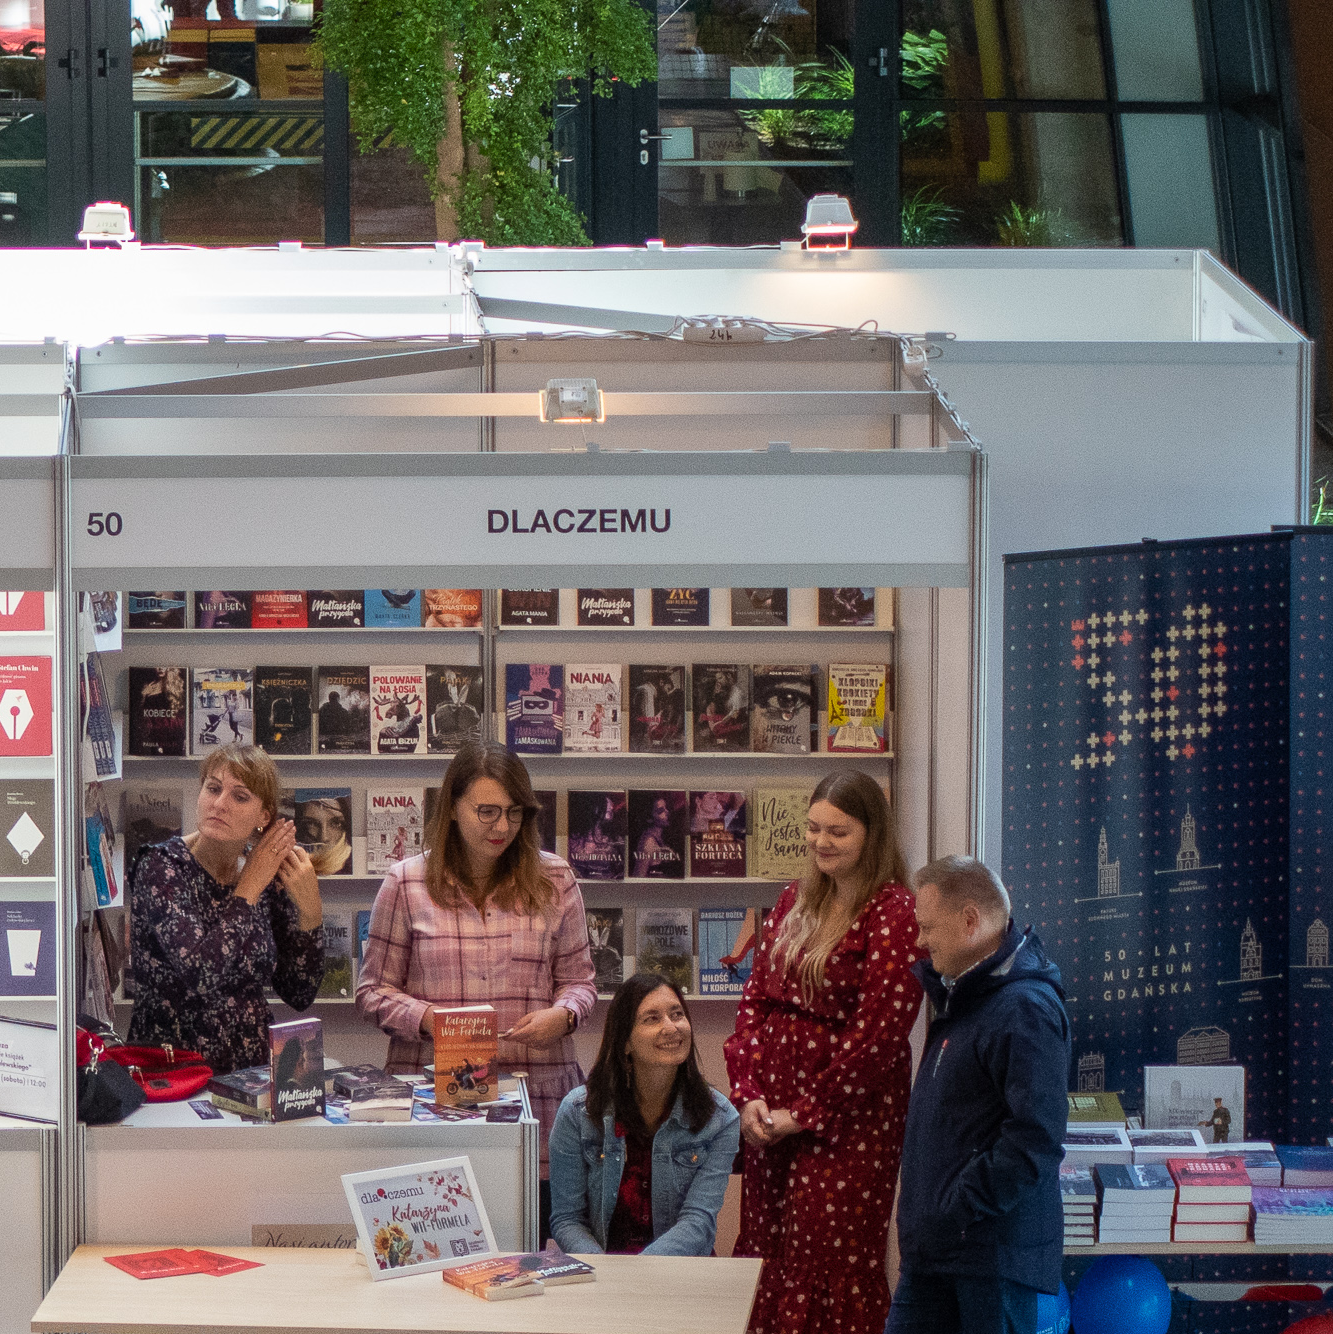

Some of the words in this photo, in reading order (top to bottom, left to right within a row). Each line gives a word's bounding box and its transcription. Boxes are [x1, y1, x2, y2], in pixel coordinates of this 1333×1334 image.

[88, 512, 124, 538] 50
[488, 509, 672, 535] DLACZEMU
[311, 599, 362, 612] Maltańska
[581, 597, 632, 610] Maltańska
[319, 609, 354, 621] przygoda
[587, 607, 624, 619] przygoda
[569, 672, 615, 685] NIANIA
[379, 685, 391, 694] NA
[143, 708, 176, 719] KOBIECE
[771, 735, 802, 745] PIEKLE
[372, 796, 416, 808] NIANIA
[762, 797, 788, 824] Nie
[695, 843, 743, 852] SZKLANA
[774, 842, 808, 858] sama
[695, 851, 743, 860] FORTECA
[700, 911, 725, 919] DARIUSZ
[1103, 950, 1127, 963] 50
[1154, 942, 1193, 957] LAT
[702, 973, 729, 983] MIŁOŚĆ
[1103, 961, 1193, 983] MUZEUM
[710, 984, 744, 992] KORPORA
[1103, 980, 1193, 1002] GDAŃSKA
[445, 1014, 487, 1027] Katarzyna
[440, 1025, 492, 1038] Wit-Formela
[5, 1052, 25, 1061] książek
[0, 1073, 26, 1086] (sobota)
[30, 1078, 47, 1088] 12:00
[278, 1086, 324, 1105] Maltańska
[283, 1098, 316, 1113] przygoda
[391, 1203, 452, 1222] Katarzyna
[411, 1213, 473, 1236] WIT-FORMELA
